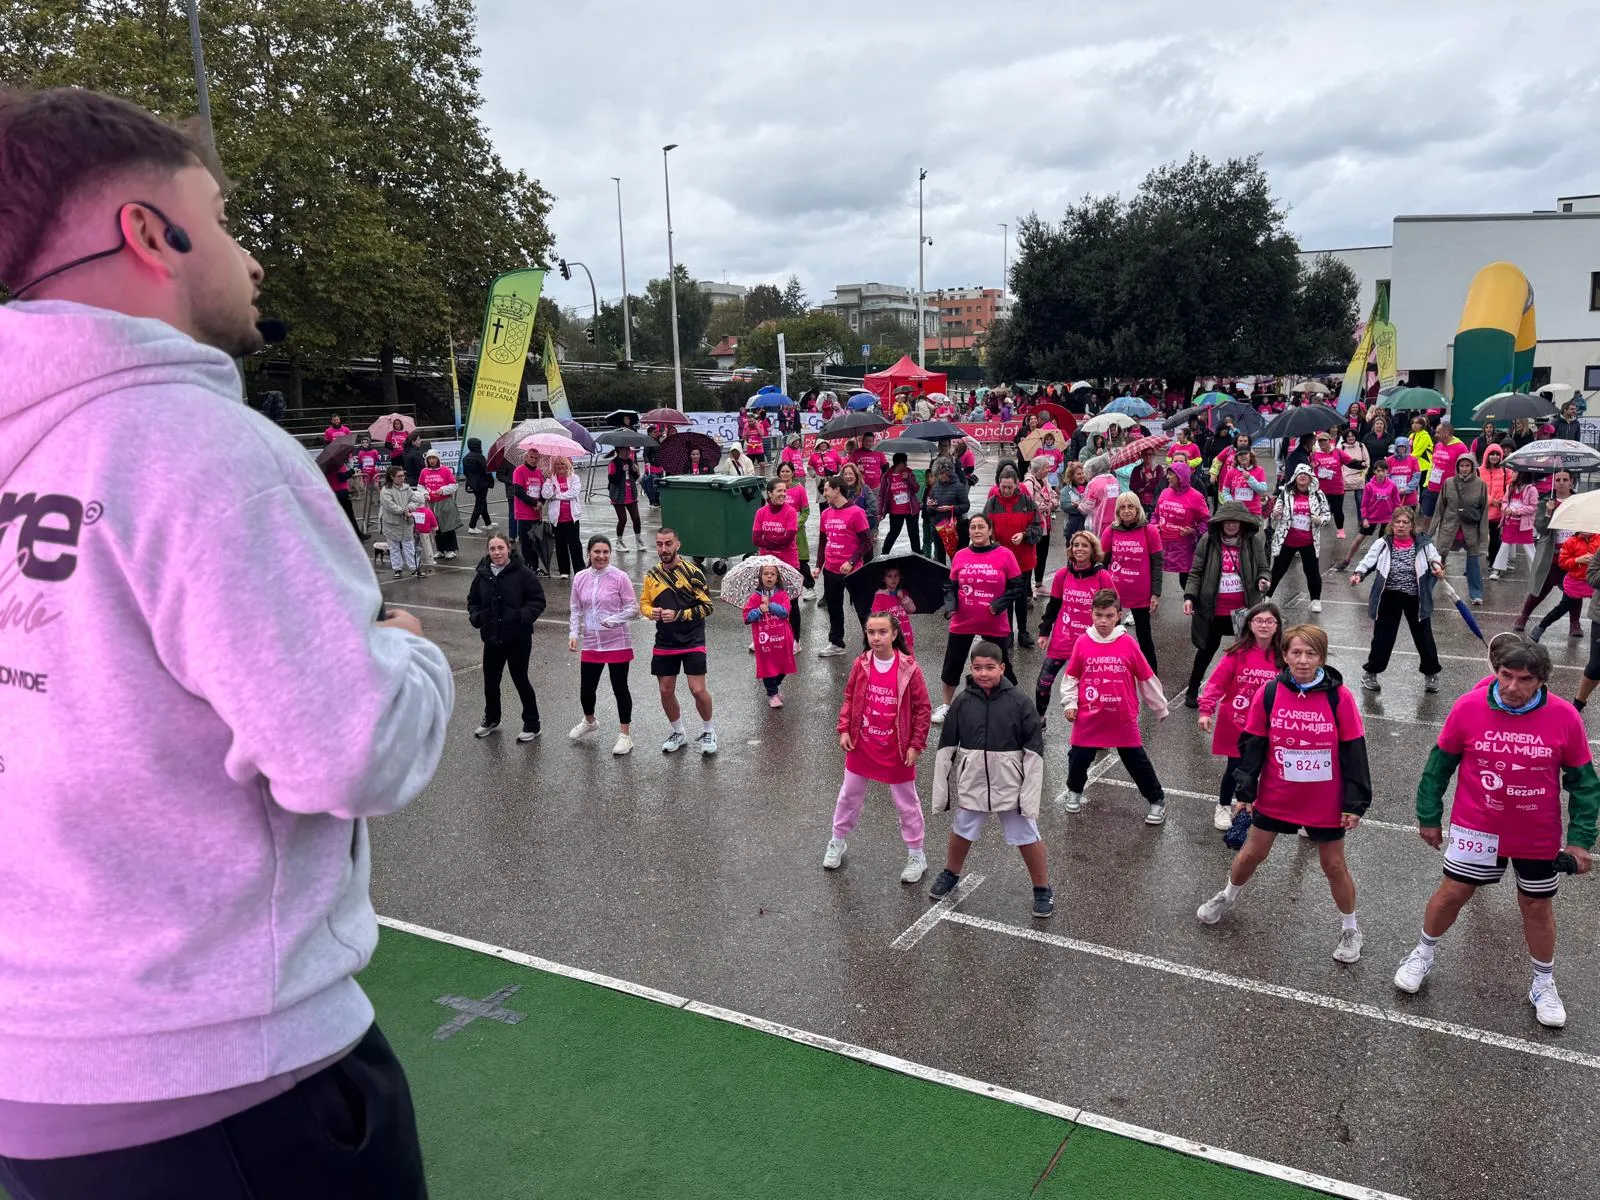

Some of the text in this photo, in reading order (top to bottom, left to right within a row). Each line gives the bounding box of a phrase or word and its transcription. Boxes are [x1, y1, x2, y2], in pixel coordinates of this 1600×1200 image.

[477, 383, 517, 397] SANTA CRUZ
[486, 391, 513, 402] BEZANA
[1114, 539, 1140, 547] CARRERA
[1222, 579, 1239, 587] 1630
[1064, 588, 1091, 598] CARRERA
[1075, 597, 1094, 605] MUJE
[1086, 656, 1122, 665] CARRERA
[1092, 665, 1103, 673] LA
[1103, 665, 1127, 674] MUJER
[1237, 675, 1248, 683] DE
[866, 684, 893, 697] ARRERA
[874, 695, 898, 706] MUJER
[1277, 708, 1326, 722] CARRERA
[868, 727, 894, 736] Bezana
[1270, 717, 1334, 735] DE LA MUJER
[1484, 730, 1545, 746] CARRERA
[1474, 740, 1553, 759] DE LA MUJER
[1296, 760, 1321, 771] 824
[1506, 787, 1546, 797] Bezana
[1457, 838, 1483, 854] 593
